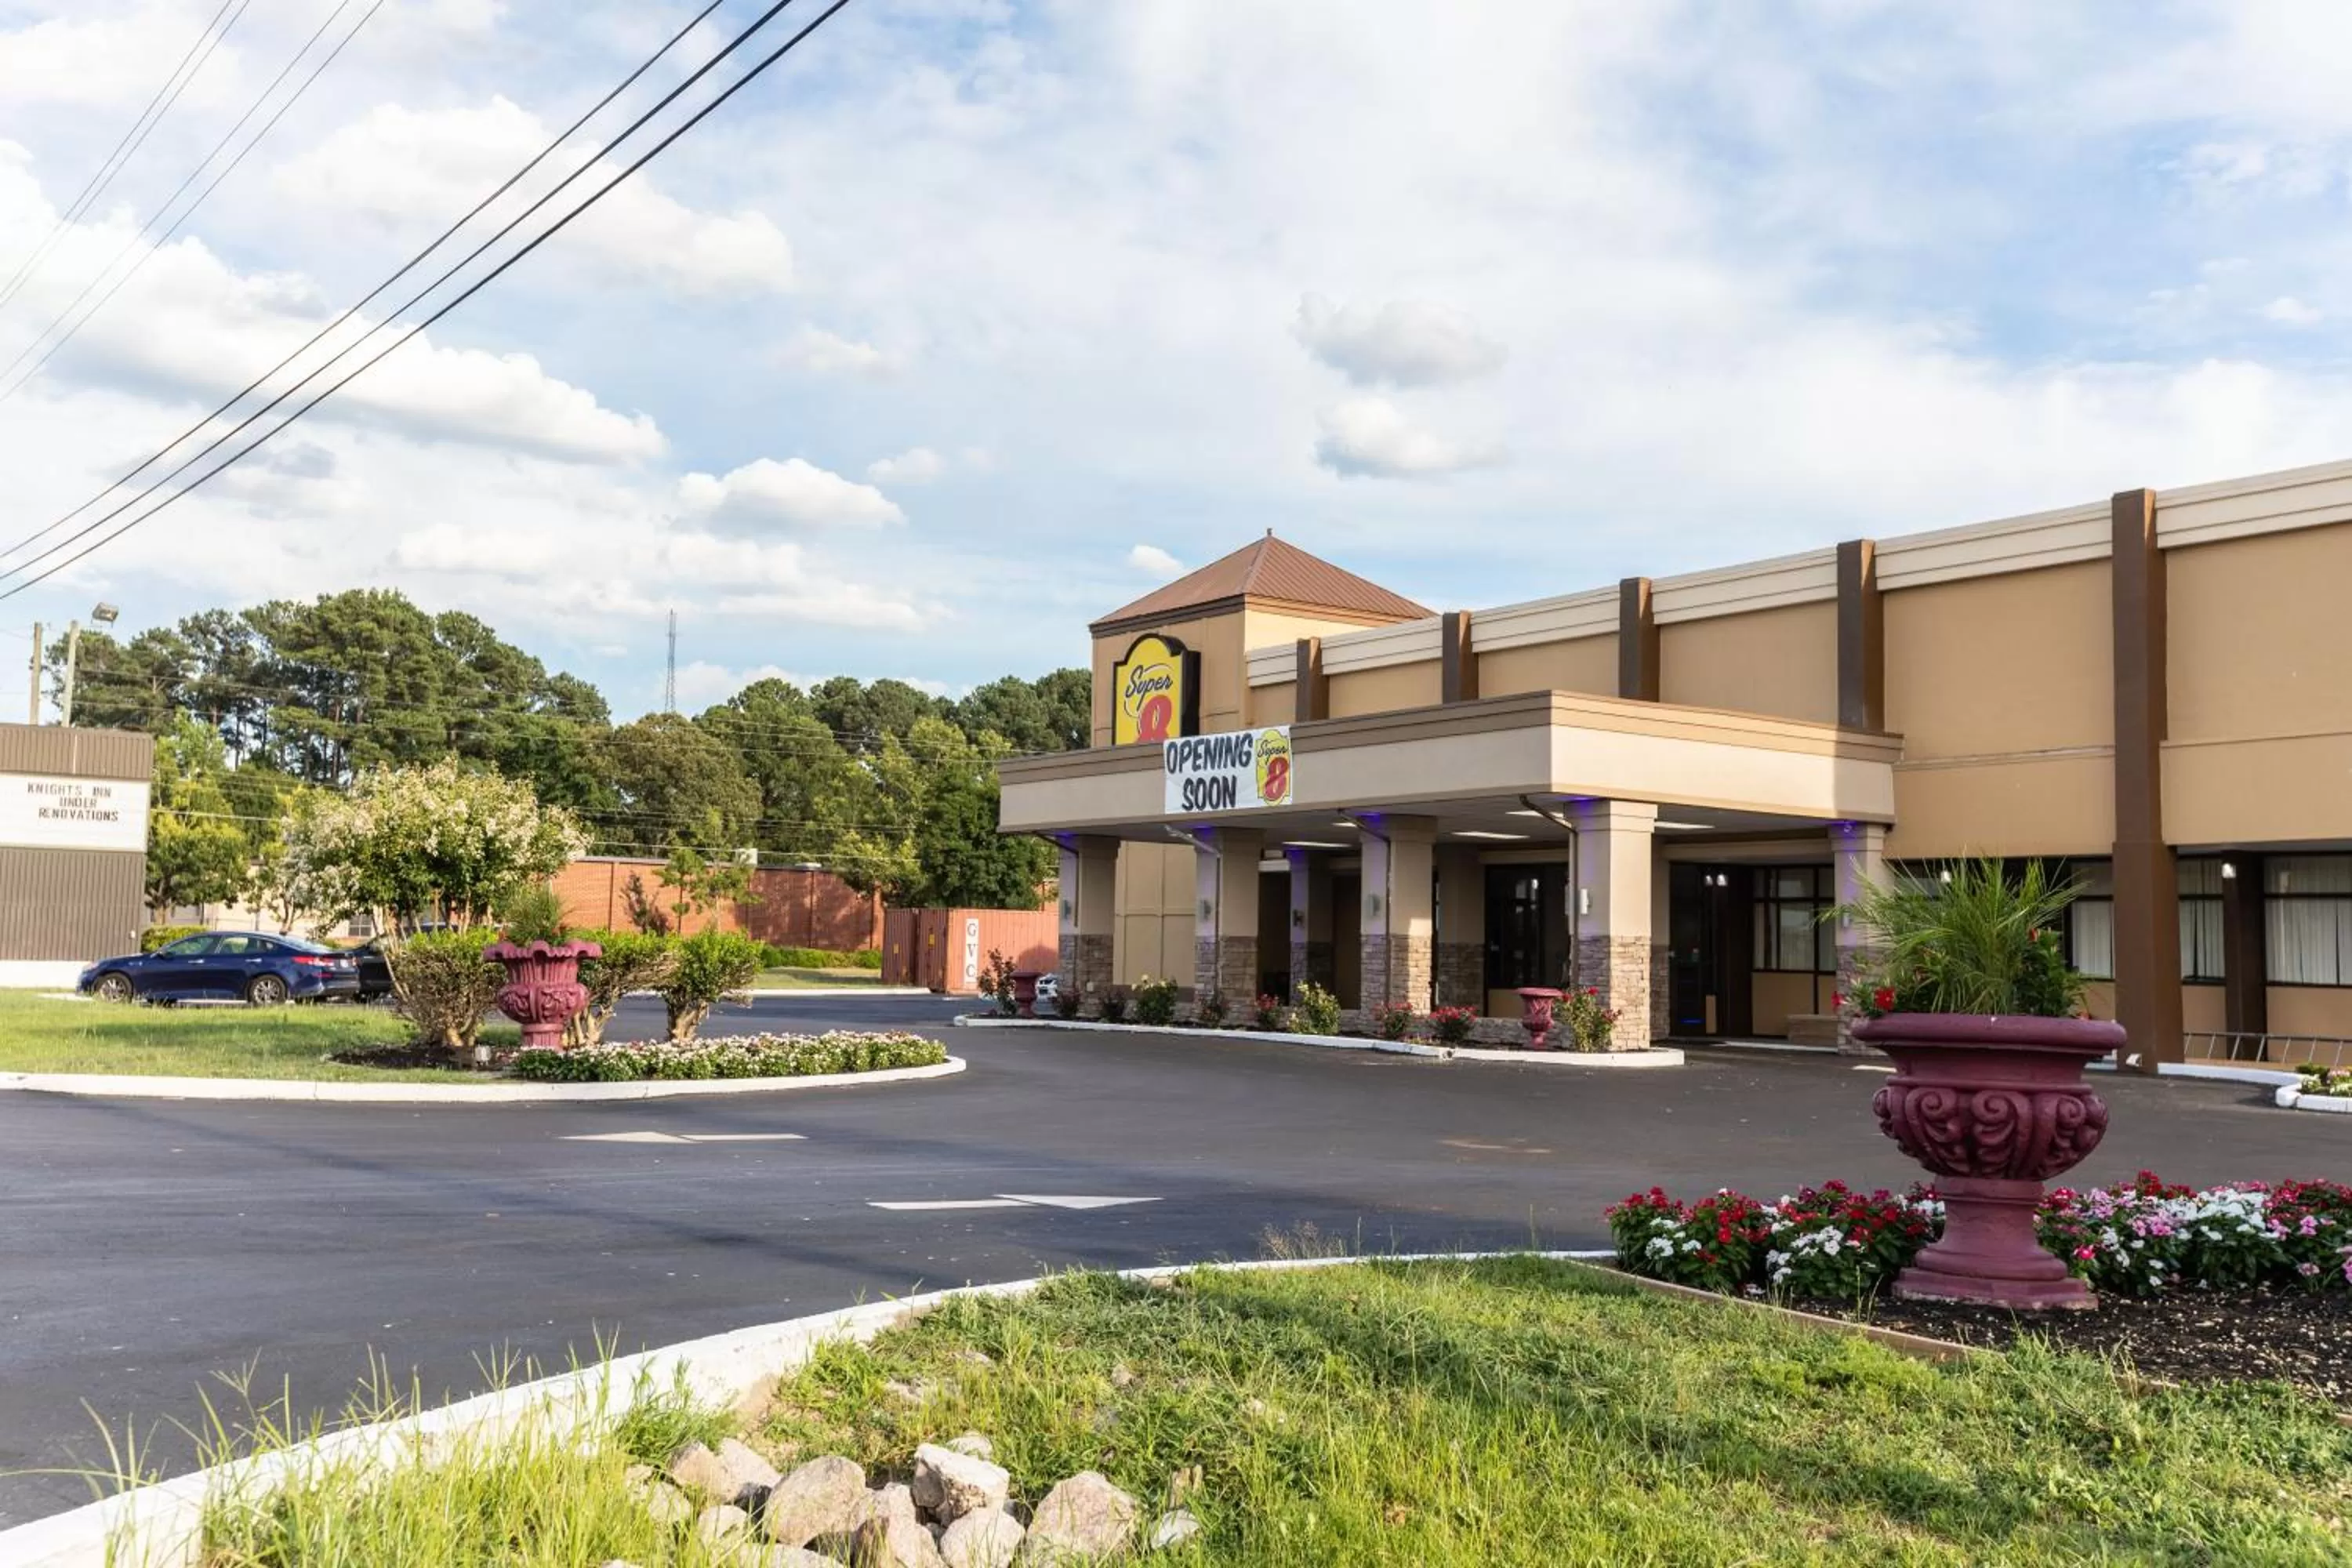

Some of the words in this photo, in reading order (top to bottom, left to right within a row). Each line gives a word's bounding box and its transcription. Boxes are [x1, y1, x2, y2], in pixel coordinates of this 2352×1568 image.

[1125, 664, 1173, 711] Super
[1138, 695, 1172, 744] 8
[1167, 733, 1254, 774] OPENING
[1258, 740, 1289, 765] Super
[27, 782, 82, 795] KNIGHTS
[1181, 776, 1237, 811] SOON
[1264, 757, 1289, 801] 8
[38, 807, 118, 822] RENOVATIONS
[60, 797, 97, 808] UNDER
